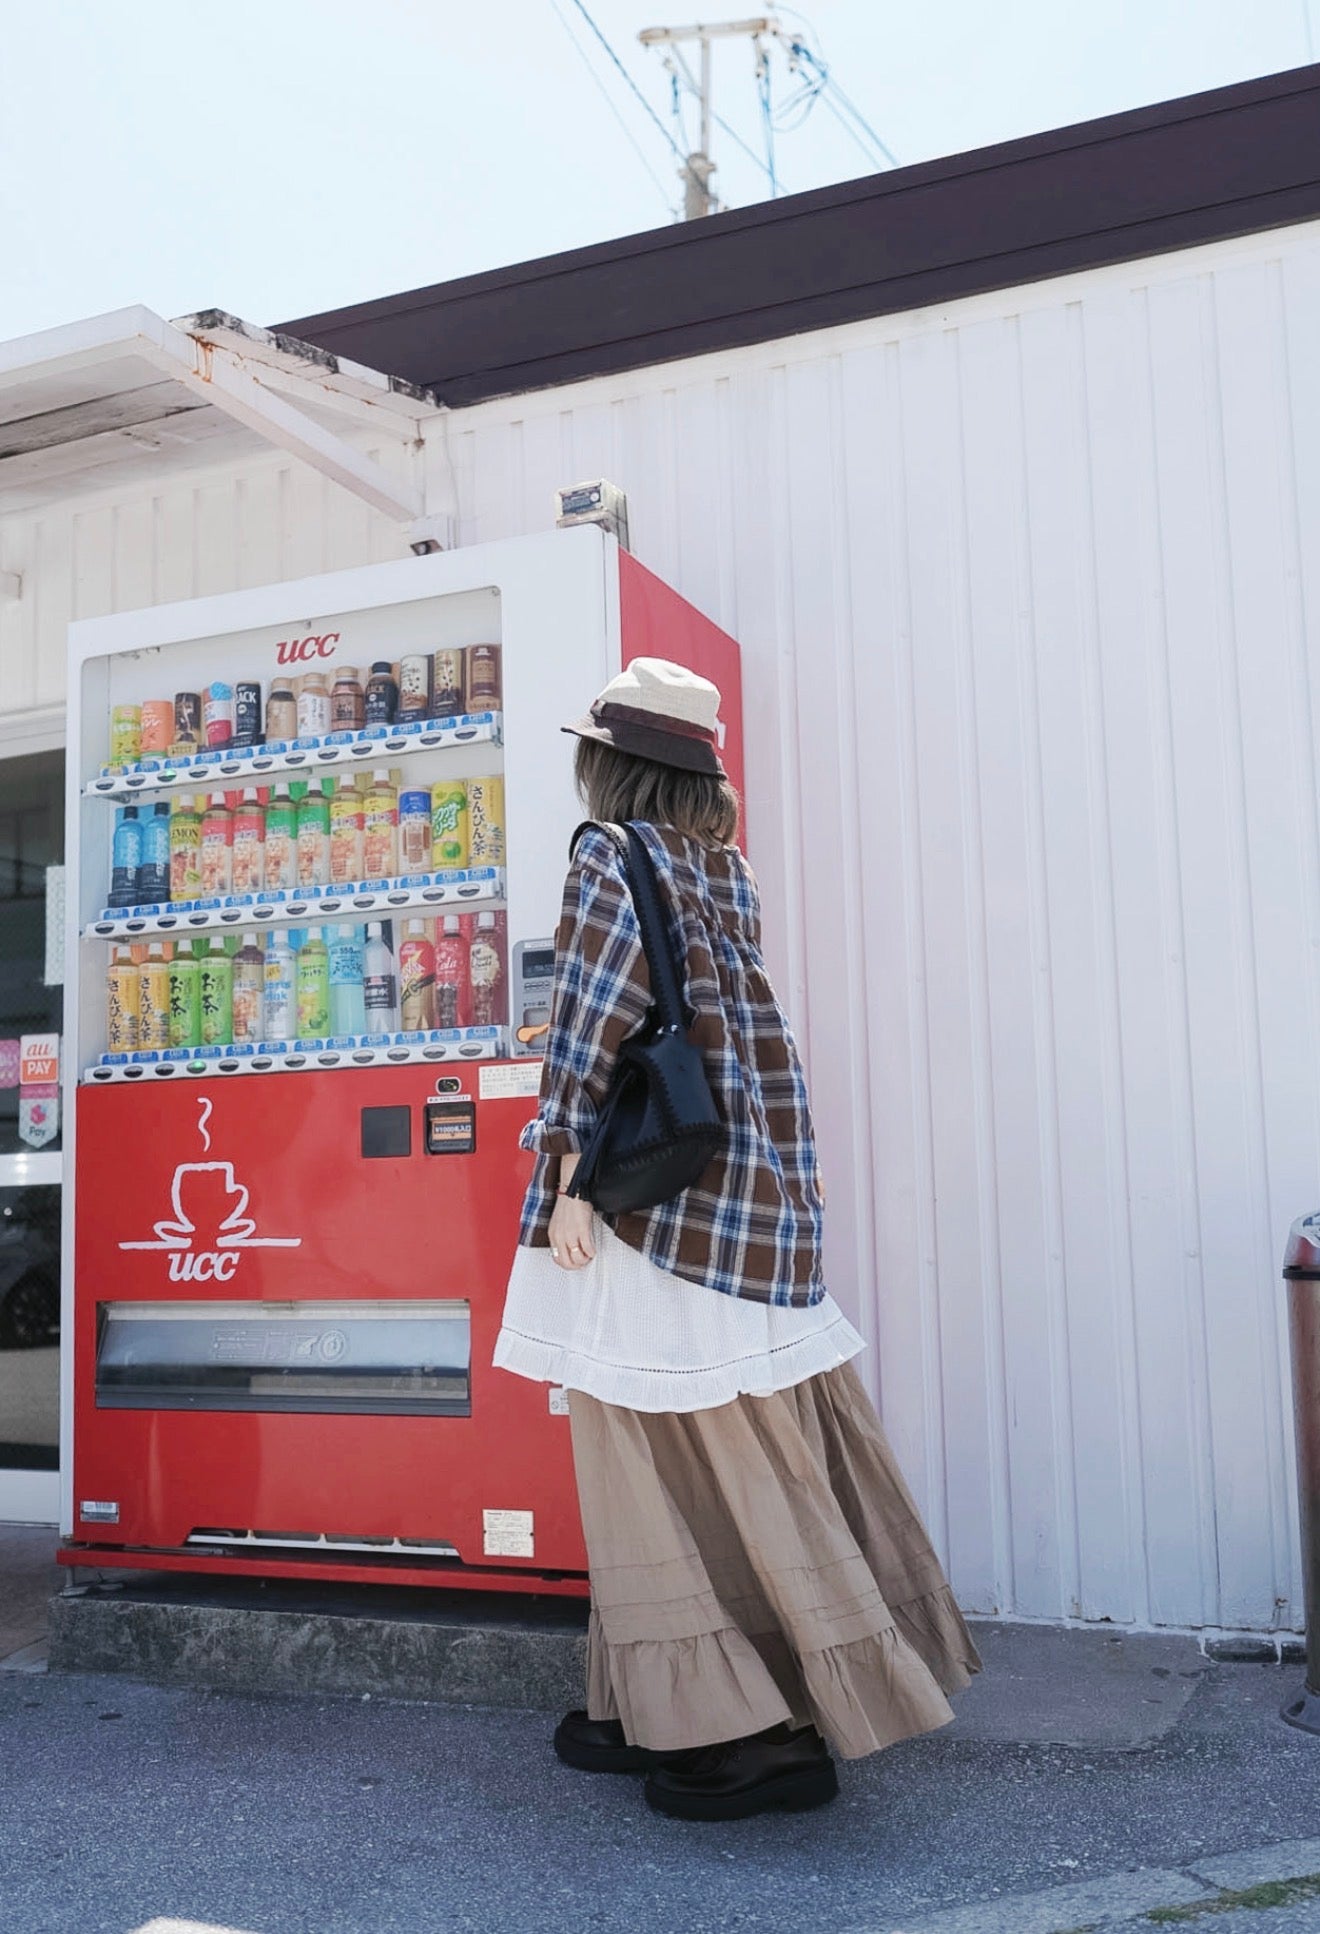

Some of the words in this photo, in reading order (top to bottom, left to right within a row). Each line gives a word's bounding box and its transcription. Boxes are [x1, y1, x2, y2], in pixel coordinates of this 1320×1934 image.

[170, 828, 198, 839] EMON
[169, 976, 187, 1018] お茶
[201, 972, 219, 1016] お茶
[27, 1044, 49, 1056] au
[27, 1061, 52, 1075] PAY
